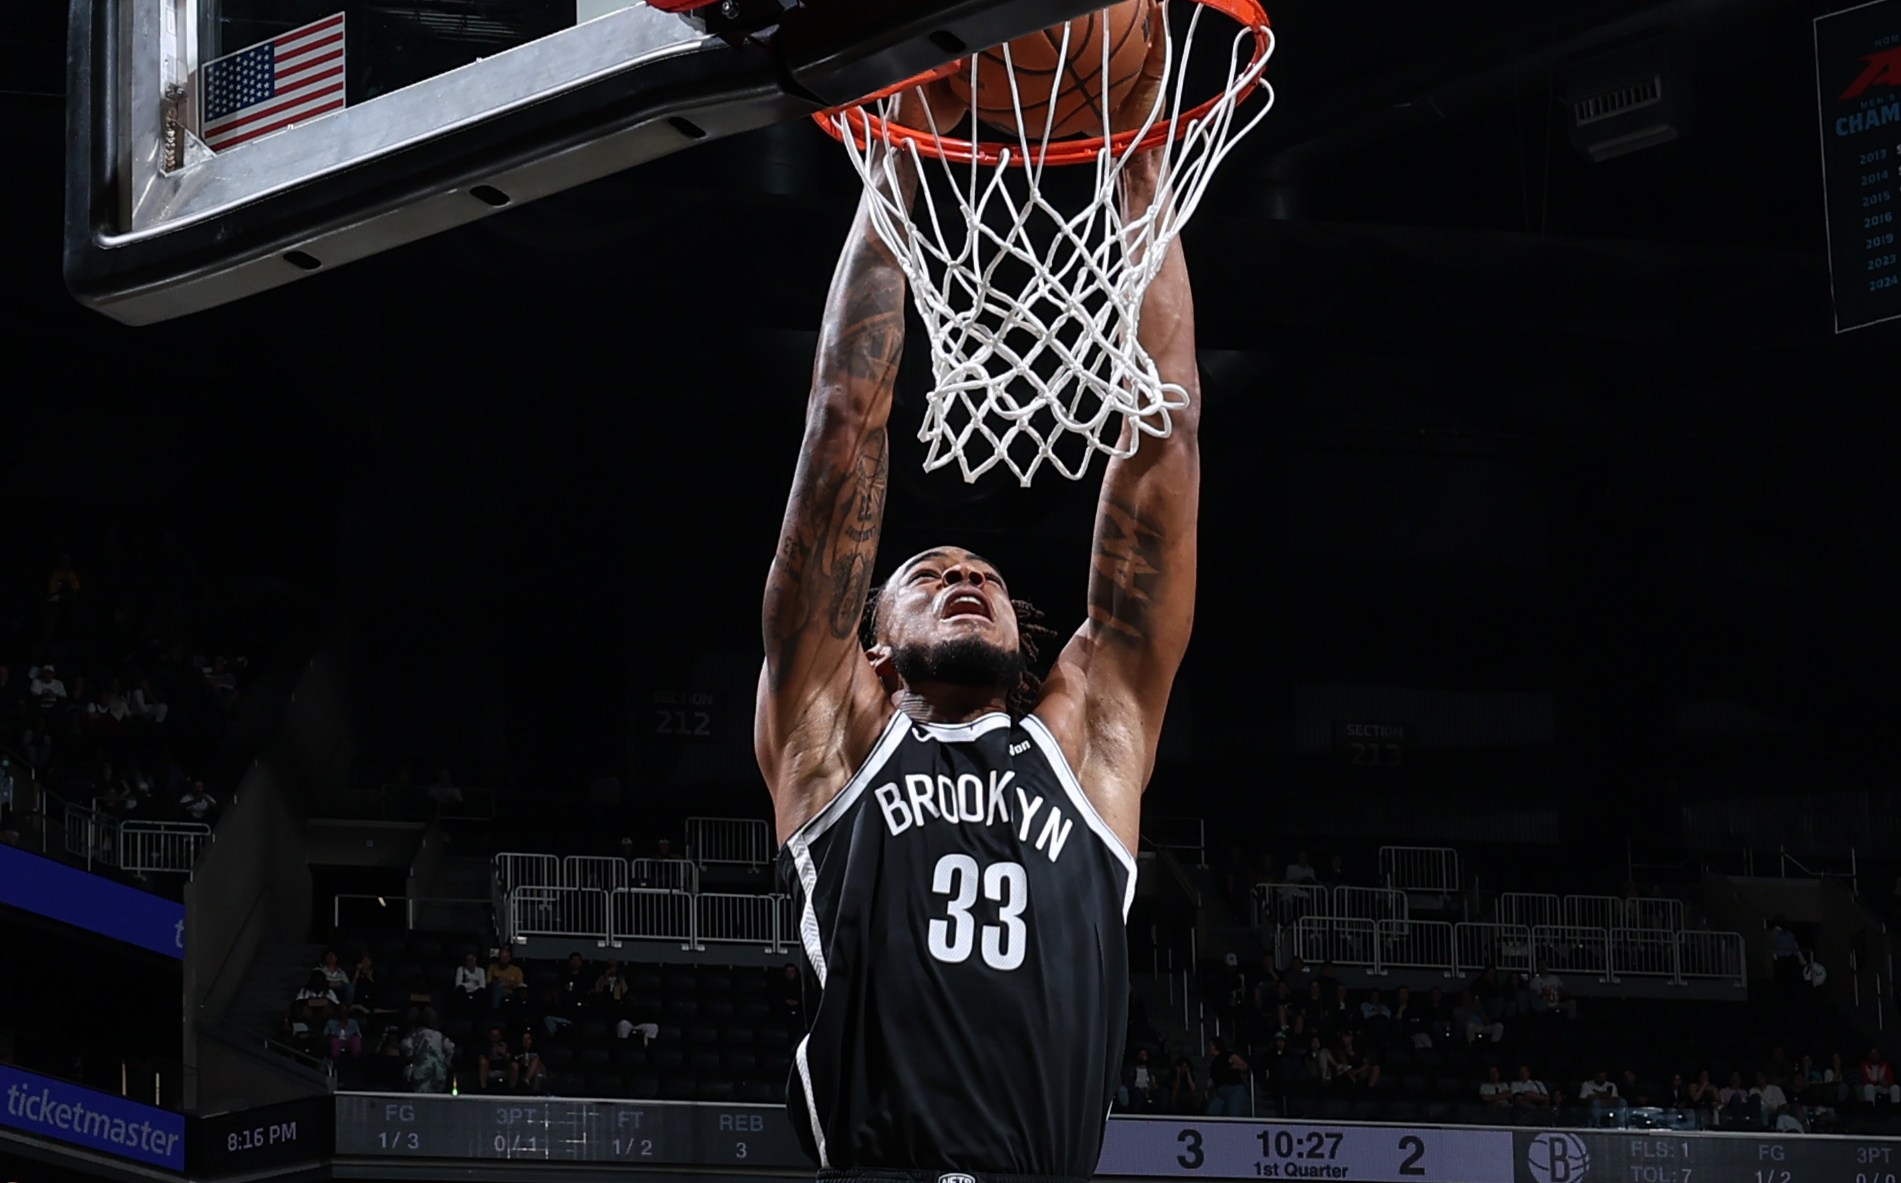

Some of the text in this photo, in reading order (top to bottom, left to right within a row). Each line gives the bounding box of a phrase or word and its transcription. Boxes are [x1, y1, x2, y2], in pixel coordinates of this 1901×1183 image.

[1860, 169, 1889, 187] 2014
[1863, 211, 1894, 229] 2016
[1864, 232, 1895, 250] 2019
[1866, 253, 1897, 271] 2023
[1868, 274, 1899, 292] 2024
[655, 710, 711, 736] 212
[1345, 723, 1404, 737] SECTION
[1351, 742, 1402, 767] 213
[927, 853, 1028, 971] 33
[6, 1082, 180, 1158] ticketmaster
[385, 1104, 415, 1122] FG
[617, 1111, 644, 1129] FT
[719, 1114, 765, 1132] REB
[226, 1121, 298, 1153] 8:16 PM
[1256, 1131, 1344, 1159] 10:27
[735, 1142, 747, 1159] 3
[1177, 1129, 1204, 1169] 3
[1398, 1136, 1426, 1176] 2
[1681, 1143, 1690, 1158] 1
[1758, 1145, 1785, 1161] FG
[1856, 1148, 1893, 1164] 3PT
[1254, 1162, 1349, 1179] 1st Quarter
[1630, 1166, 1676, 1183] TOL:
